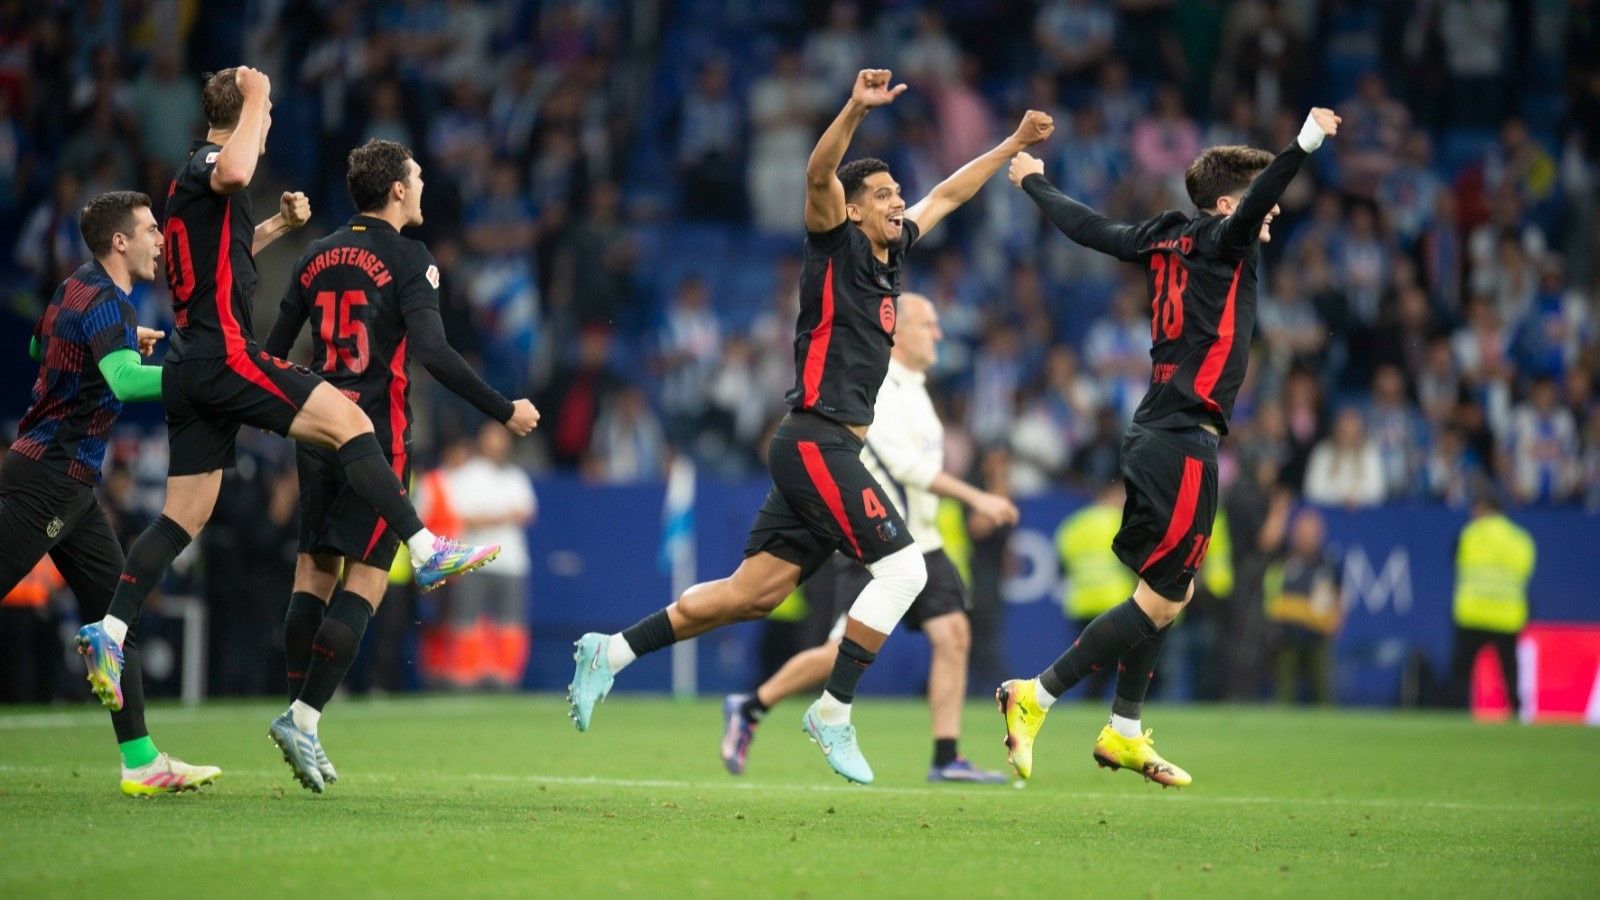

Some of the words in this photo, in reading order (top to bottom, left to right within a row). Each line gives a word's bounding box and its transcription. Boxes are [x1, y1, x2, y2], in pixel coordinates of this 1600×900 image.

[300, 246, 393, 288] CHRISTENSEN
[314, 290, 370, 374] 15
[862, 487, 888, 519] 4
